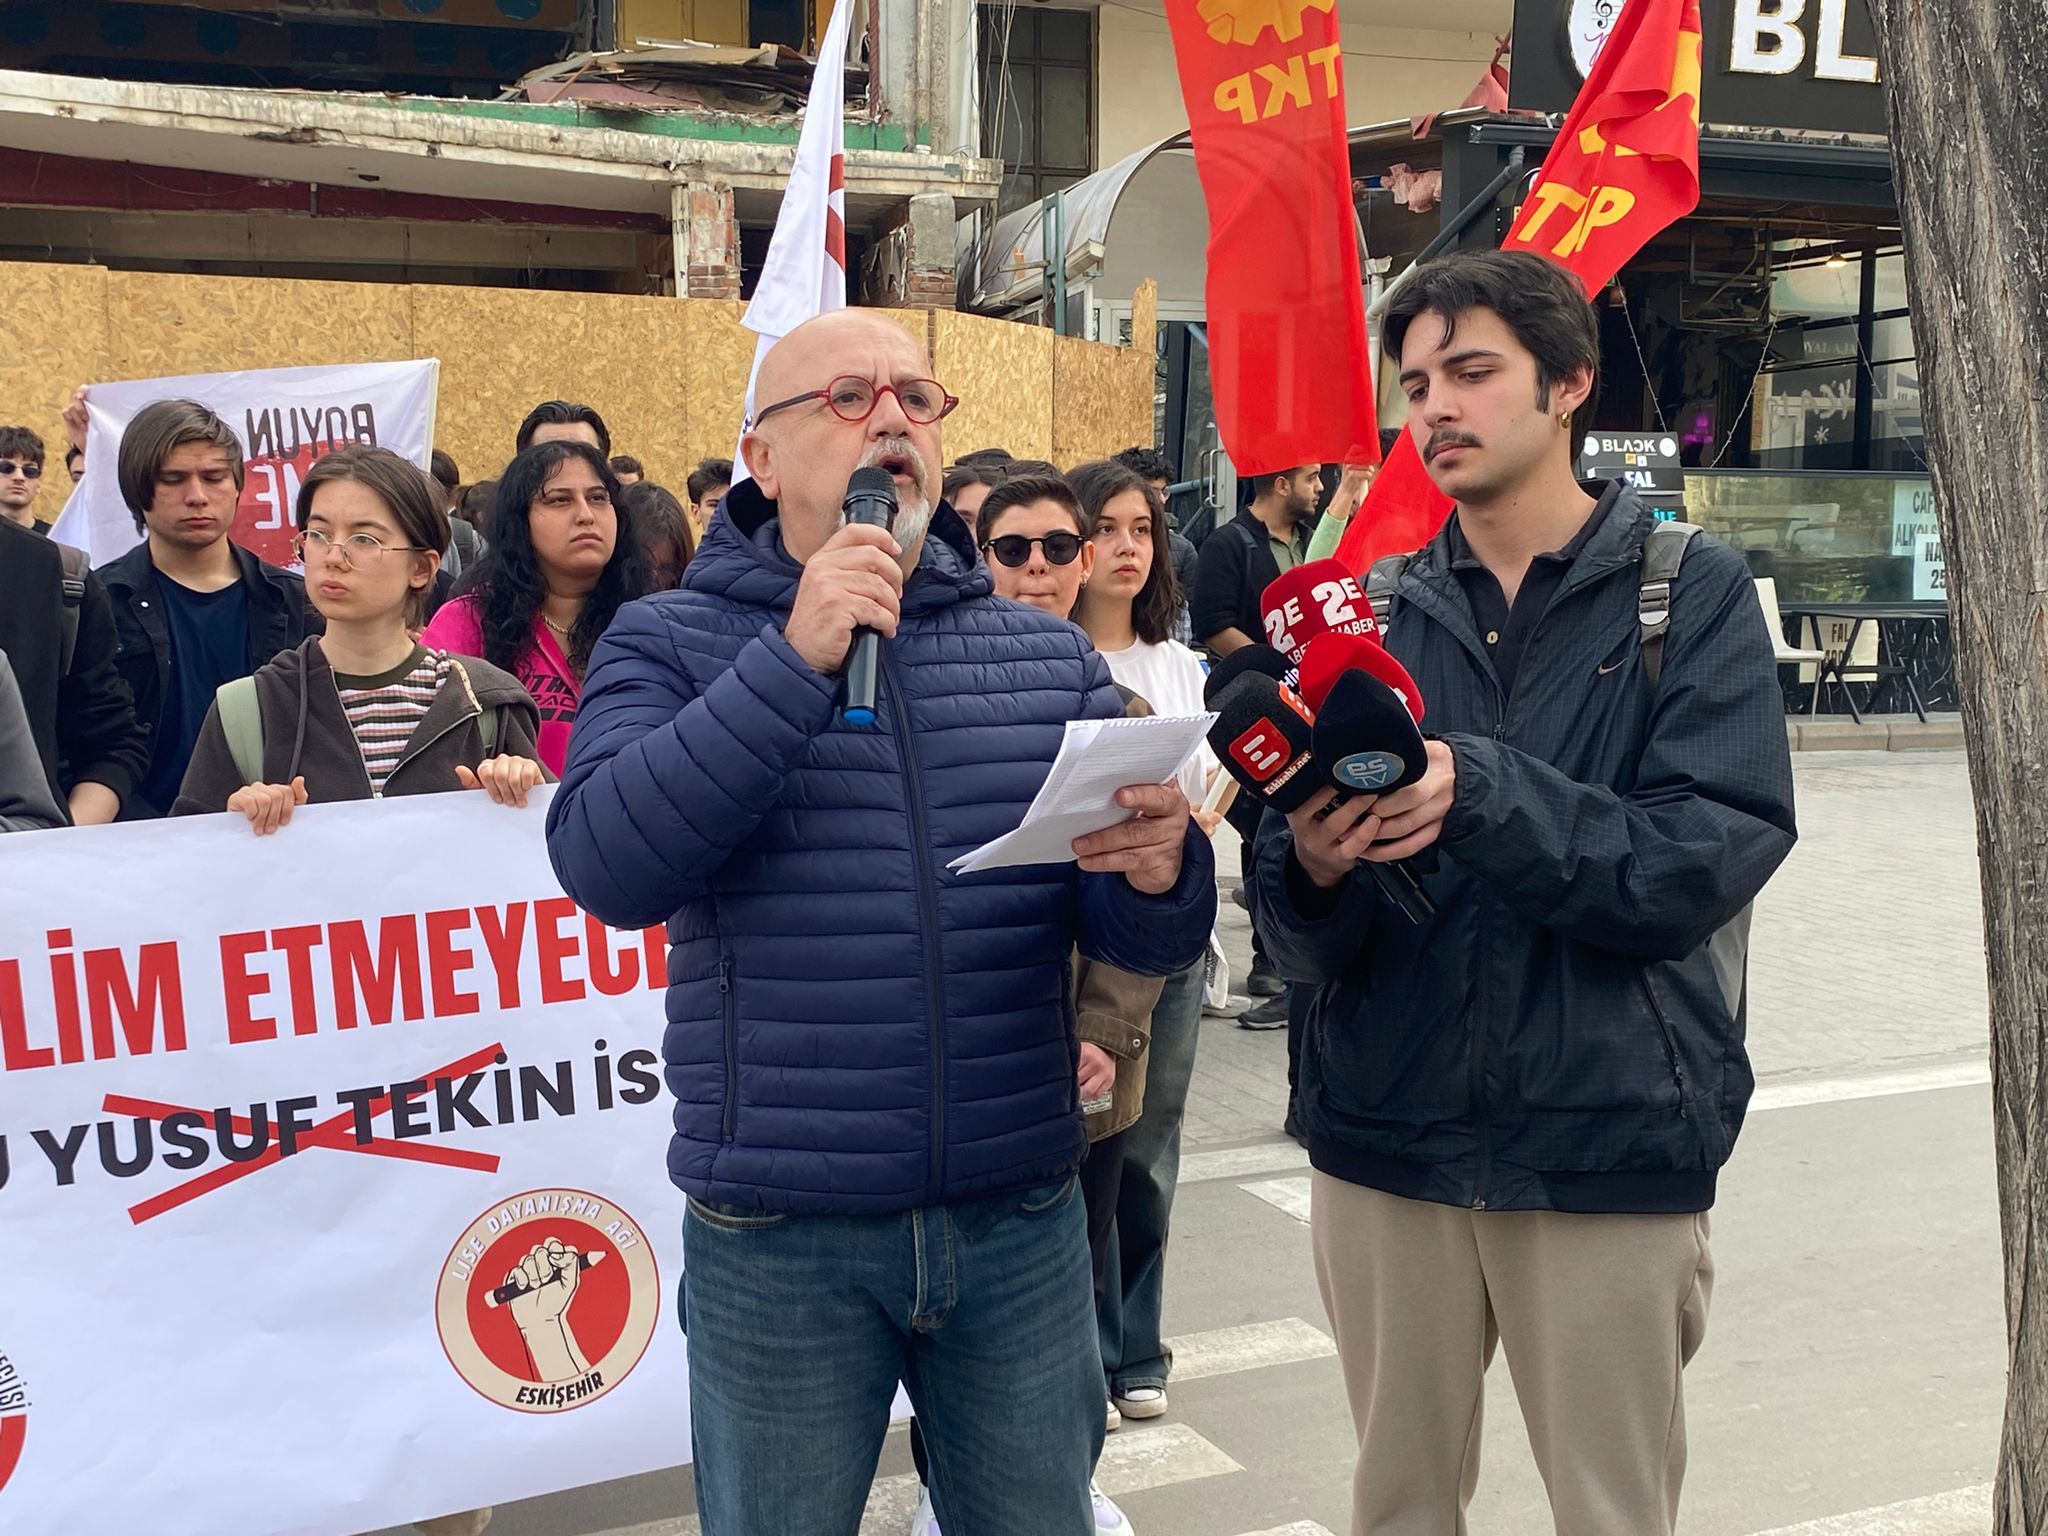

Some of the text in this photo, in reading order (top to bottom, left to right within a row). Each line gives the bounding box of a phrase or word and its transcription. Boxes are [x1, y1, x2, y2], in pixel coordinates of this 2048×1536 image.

[1624, 471, 1656, 488] FAL
[1913, 491, 1938, 514] CAF
[1925, 542, 1945, 561] NA
[1311, 577, 1362, 626] 2E
[1264, 596, 1304, 654] 2E
[1331, 617, 1376, 635] ABER
[30, 1096, 317, 1186] YUSUF
[336, 1052, 575, 1146] TEKİN
[594, 1038, 661, 1111] İS
[452, 1195, 639, 1281] LİSE DAYANIŞMA AĞI
[515, 1371, 605, 1408] ESKİŞEHİR
